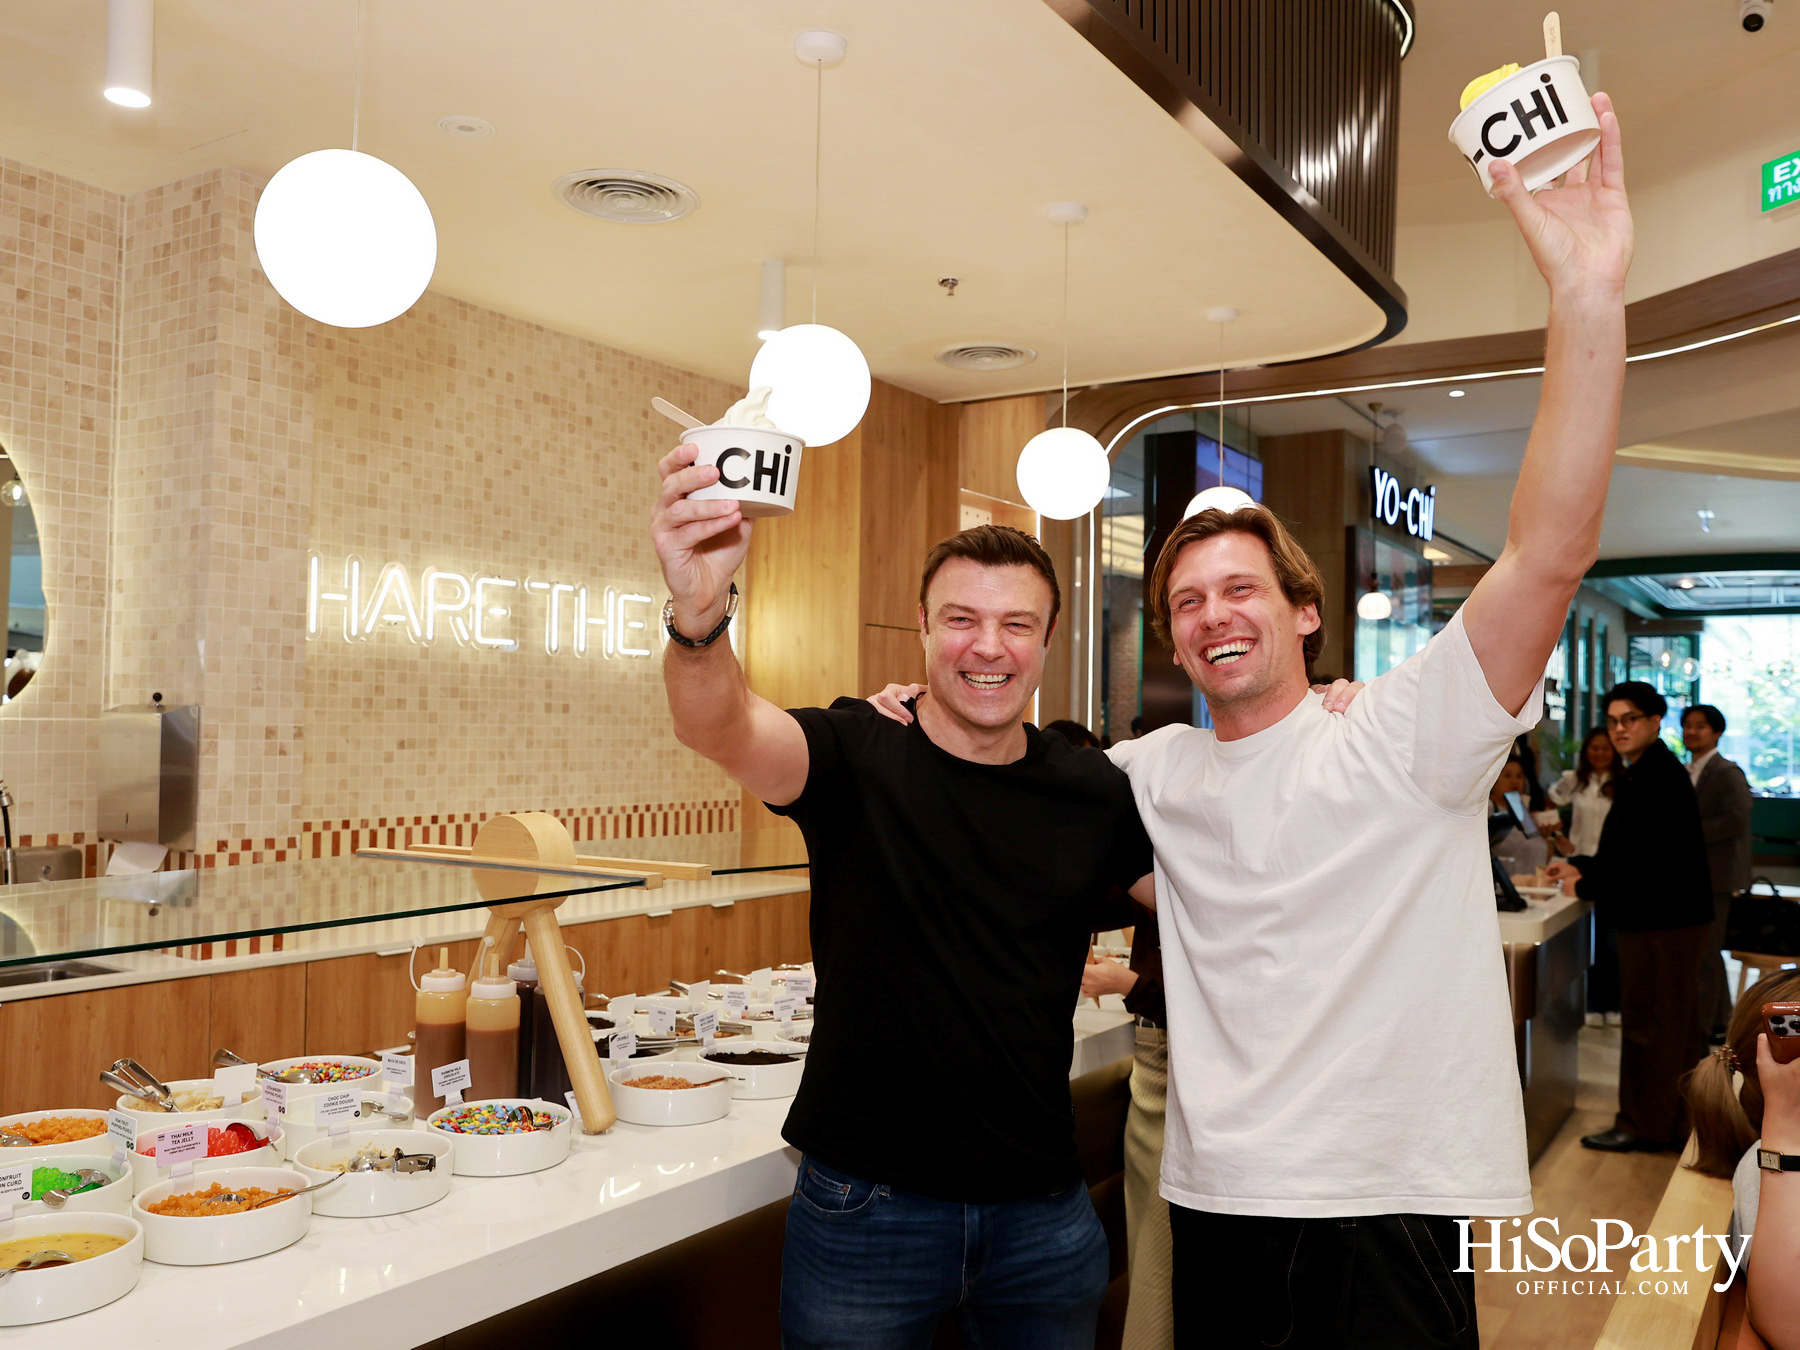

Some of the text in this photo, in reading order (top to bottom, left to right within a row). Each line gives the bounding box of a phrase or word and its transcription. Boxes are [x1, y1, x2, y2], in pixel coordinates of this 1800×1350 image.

[1463, 73, 1569, 182] -CHi
[689, 444, 792, 496] CHi
[309, 554, 518, 648] HARE
[526, 581, 653, 657] THE
